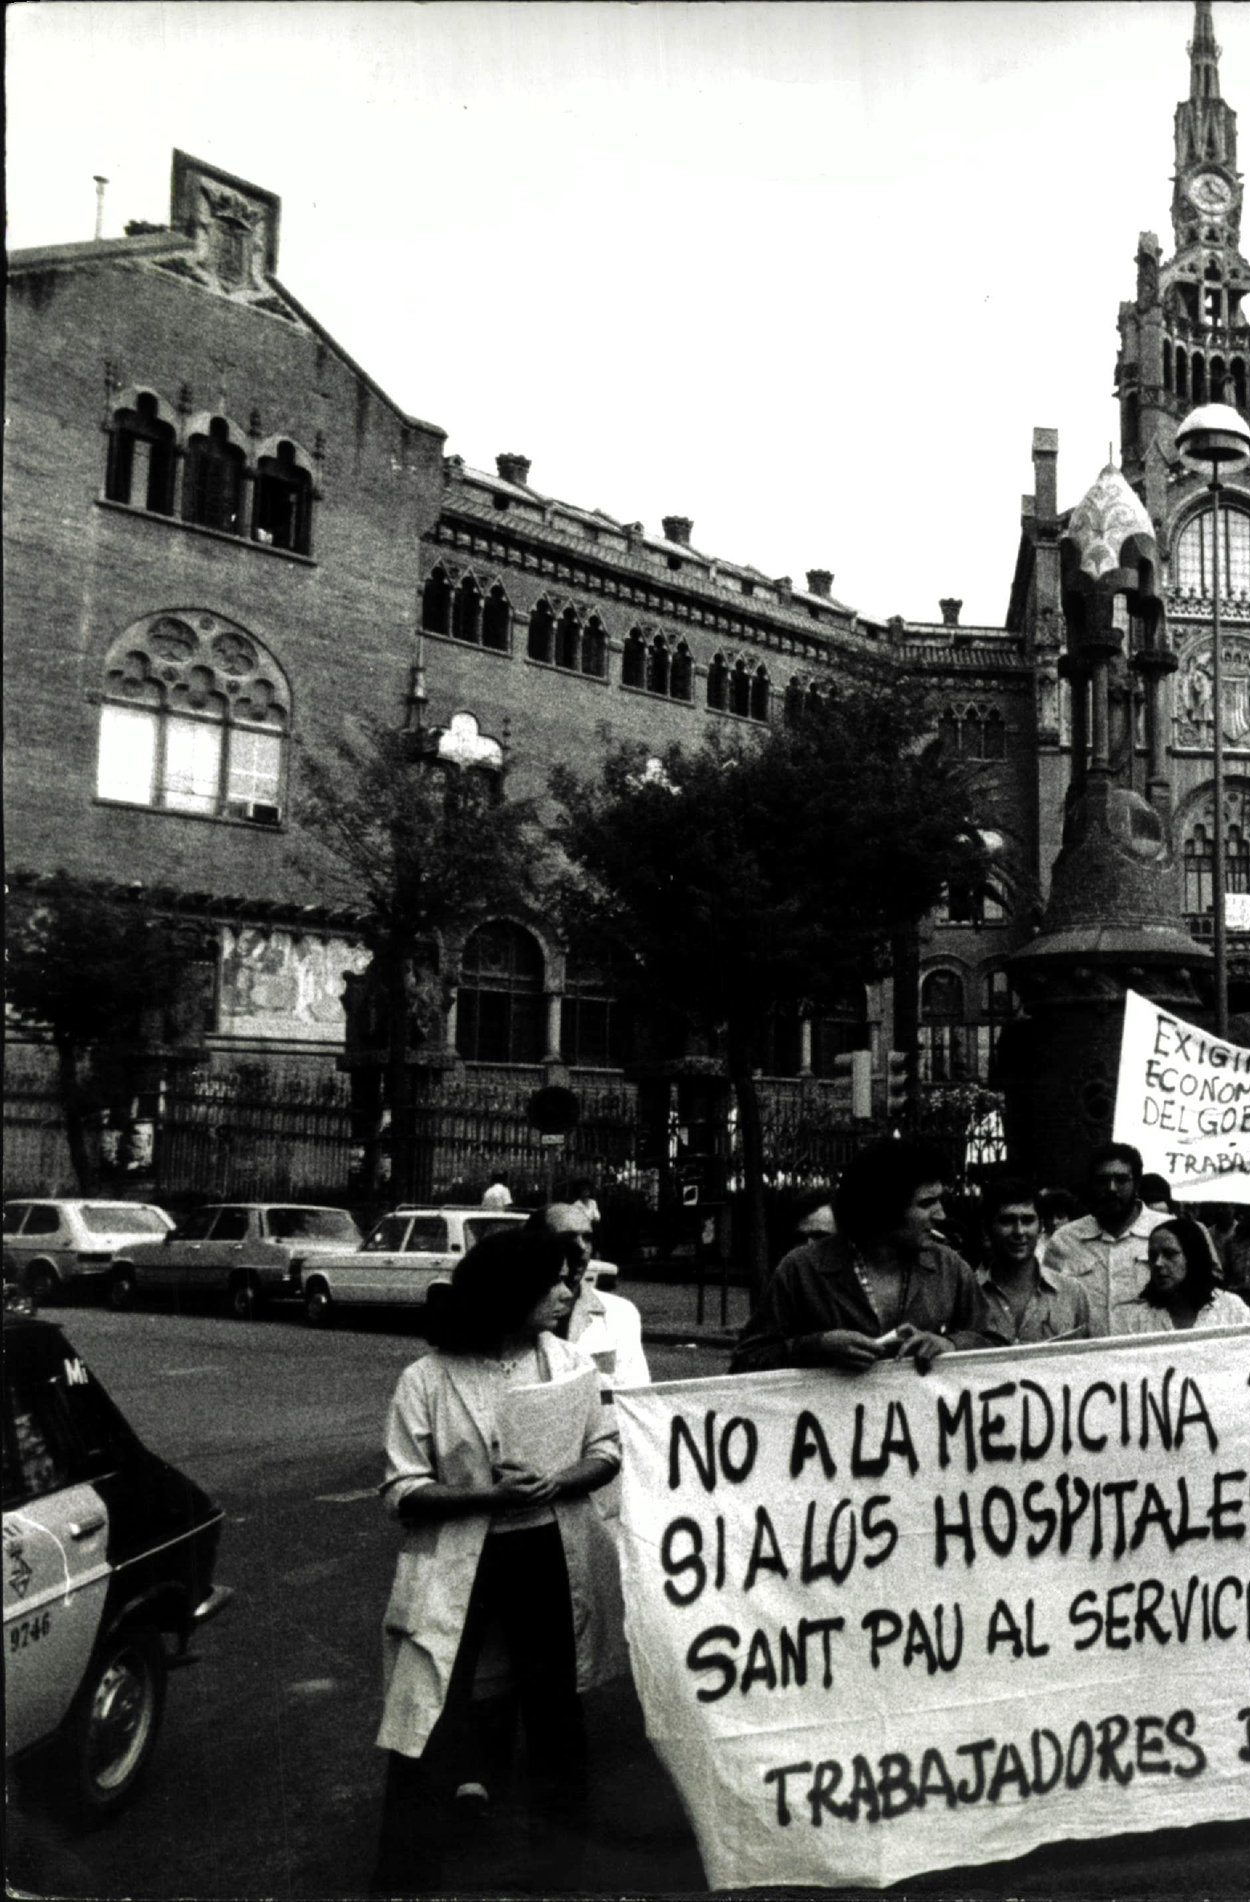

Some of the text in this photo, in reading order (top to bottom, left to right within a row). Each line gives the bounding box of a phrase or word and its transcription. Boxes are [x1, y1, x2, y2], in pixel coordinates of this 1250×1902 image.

[1142, 1096, 1189, 1132] DEL
[668, 1409, 758, 1494] NO
[789, 1409, 838, 1480] A
[850, 1400, 920, 1478] LA
[937, 1366, 1219, 1474] MEDICINA
[660, 1514, 725, 1606] SI
[743, 1503, 789, 1592] A
[801, 1494, 900, 1586] LOS
[686, 1616, 845, 1702] SANT
[861, 1601, 964, 1676] PAU
[987, 1598, 1049, 1658] AL
[763, 1708, 1208, 1828] TRABAJADORES
